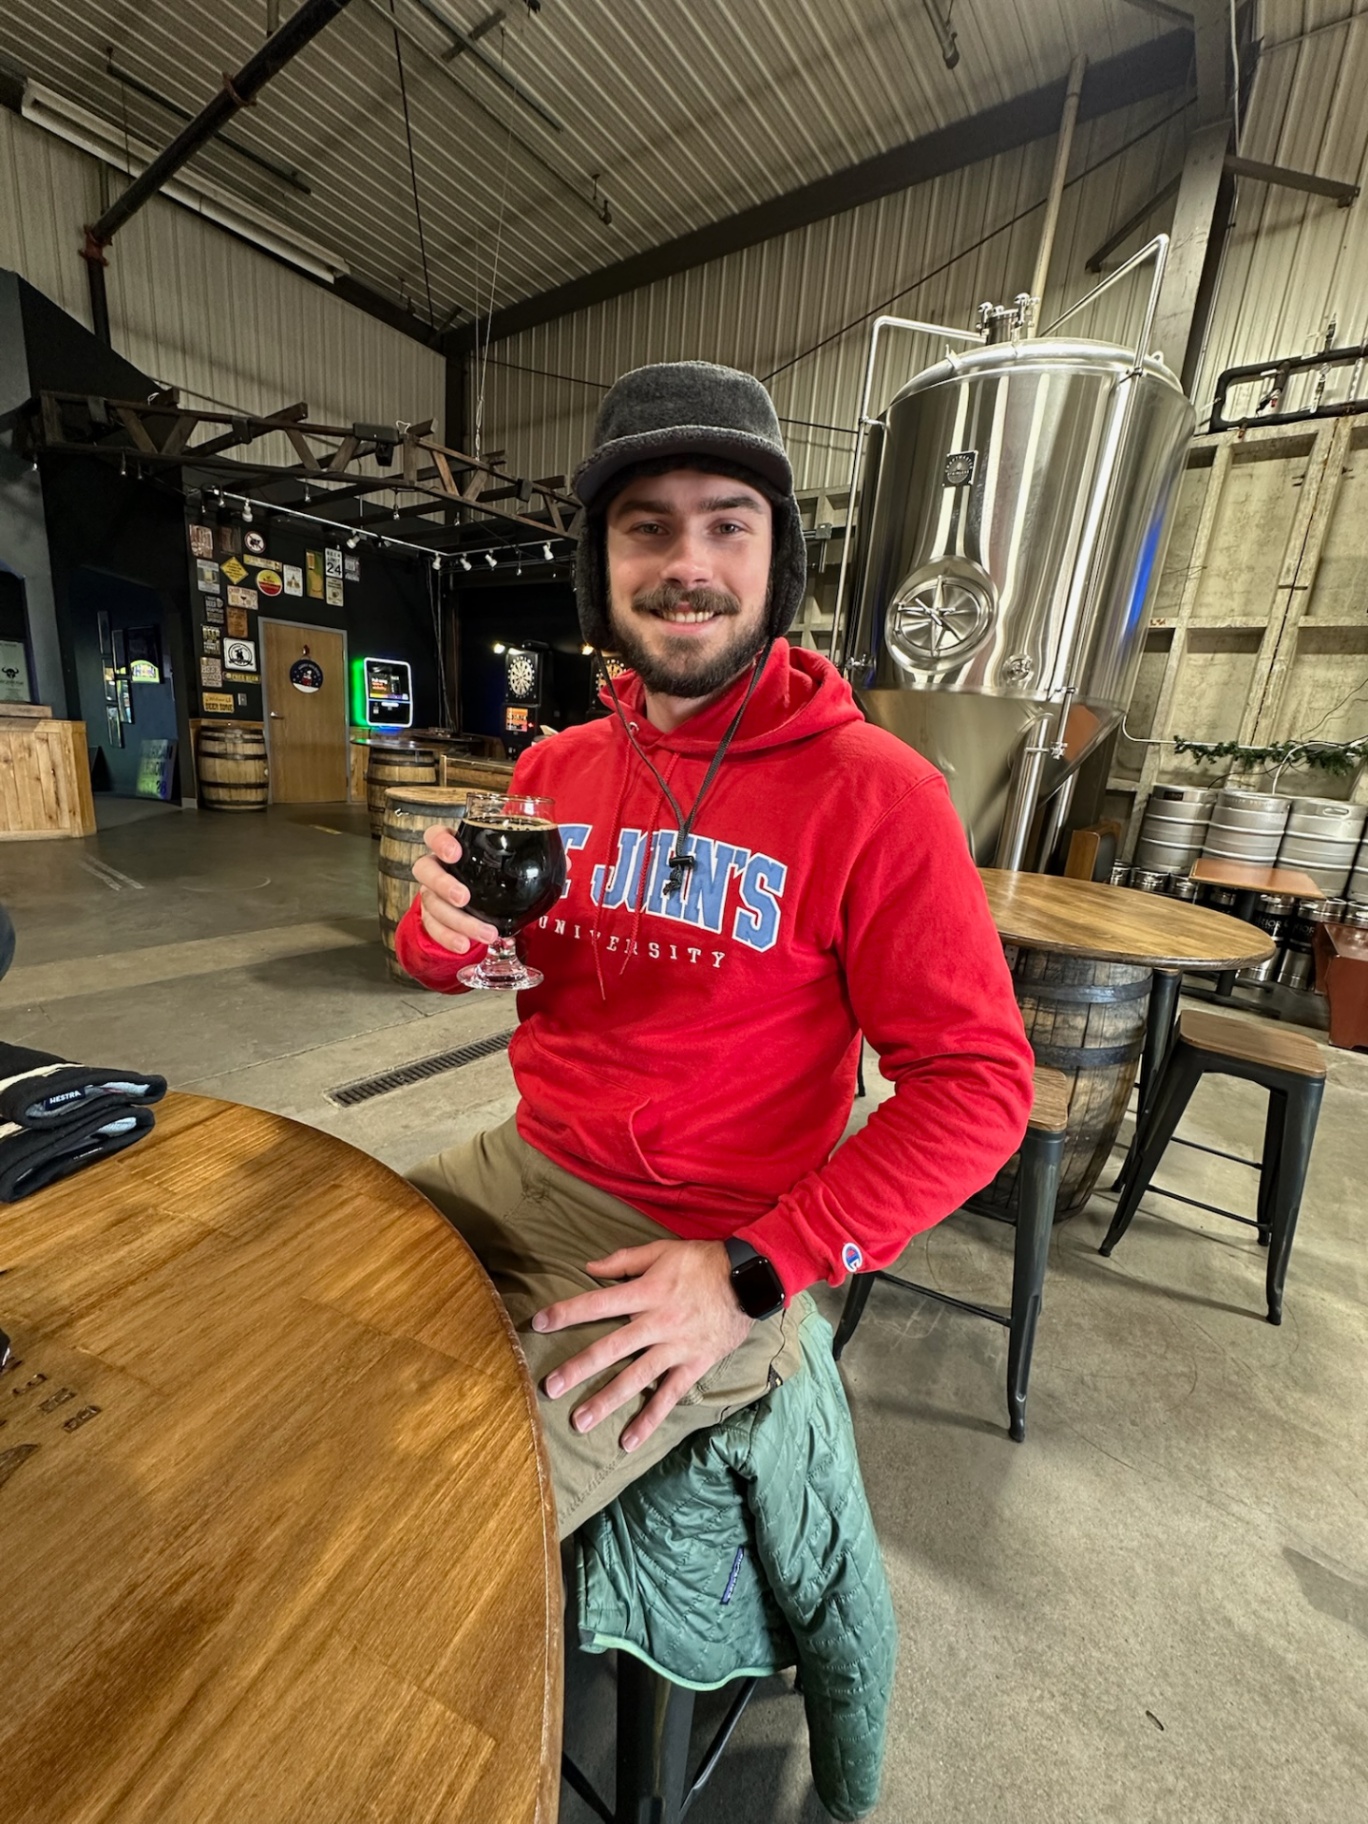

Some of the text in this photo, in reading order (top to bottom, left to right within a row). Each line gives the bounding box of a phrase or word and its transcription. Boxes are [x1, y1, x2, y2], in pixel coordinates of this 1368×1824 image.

[326, 562, 342, 576] 24
[590, 827, 788, 953] JOHN'S
[538, 915, 726, 969] UNIVERSITY
[49, 1090, 82, 1104] HESTRA
